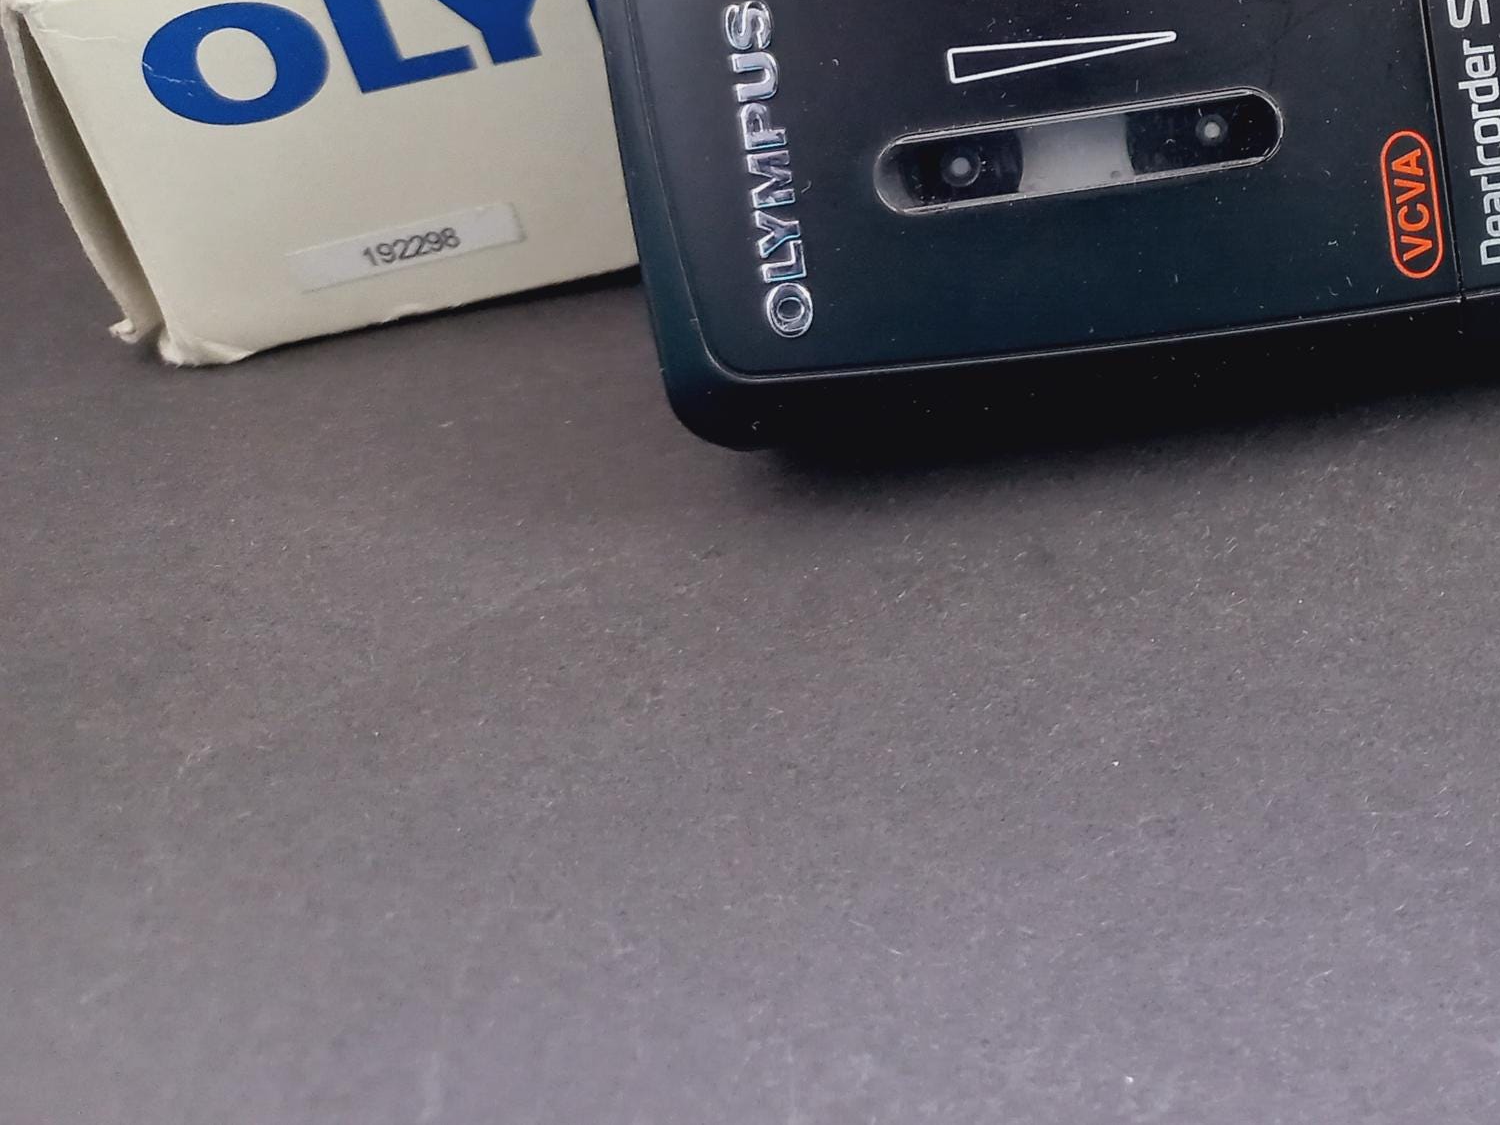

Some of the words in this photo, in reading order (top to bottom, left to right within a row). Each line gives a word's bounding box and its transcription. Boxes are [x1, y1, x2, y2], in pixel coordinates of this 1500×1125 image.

[725, 0, 814, 338] OLYMPUS
[1391, 147, 1433, 262] VCVA
[362, 227, 462, 266] 192298
